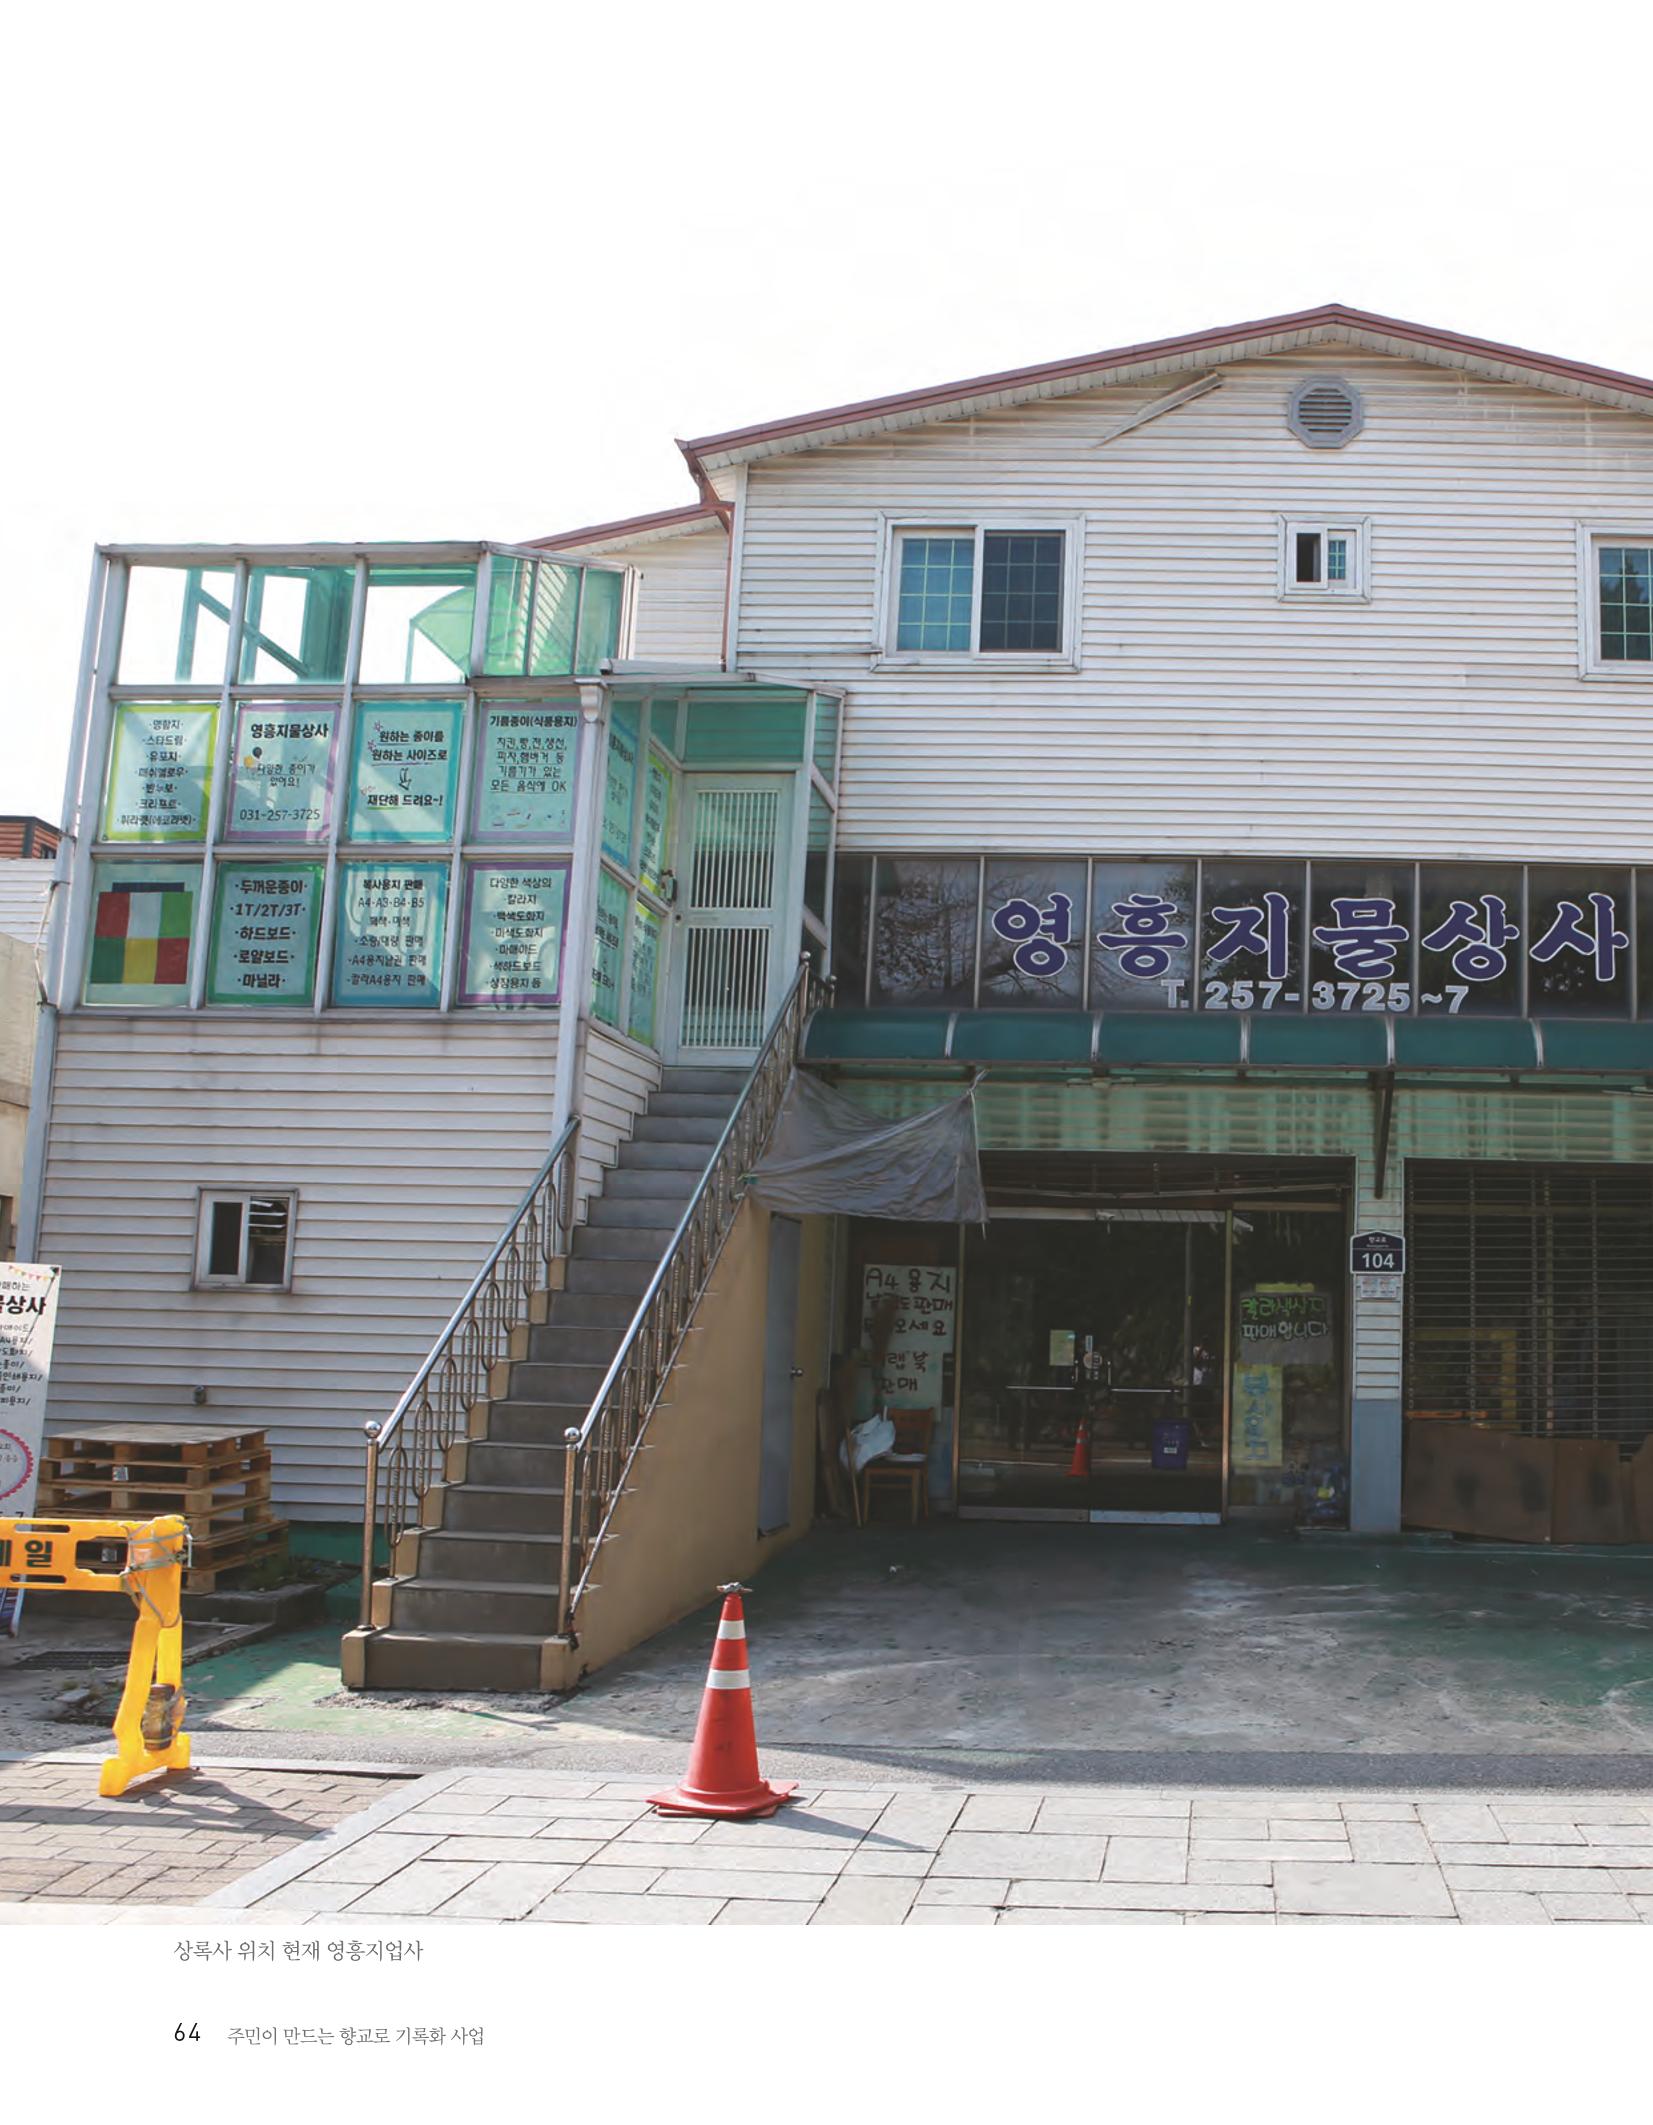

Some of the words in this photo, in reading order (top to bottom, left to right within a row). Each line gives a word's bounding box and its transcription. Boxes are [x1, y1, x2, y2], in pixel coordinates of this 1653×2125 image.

[251, 723, 329, 739] 영흥지물상사
[379, 730, 410, 742] 원하는
[413, 730, 445, 742] 종이를
[372, 749, 403, 761] 원하는
[407, 749, 448, 761] 사이즈로
[551, 781, 567, 792] OK
[367, 794, 400, 806] 재단해
[239, 808, 321, 821] 031-257-3725
[363, 879, 401, 890] 복사용지
[489, 877, 519, 888] 다양한
[521, 877, 552, 888] 색상의
[991, 891, 1630, 982] 영흥지물상사
[1160, 980, 1189, 1009] T.
[1362, 1252, 1394, 1269] 104
